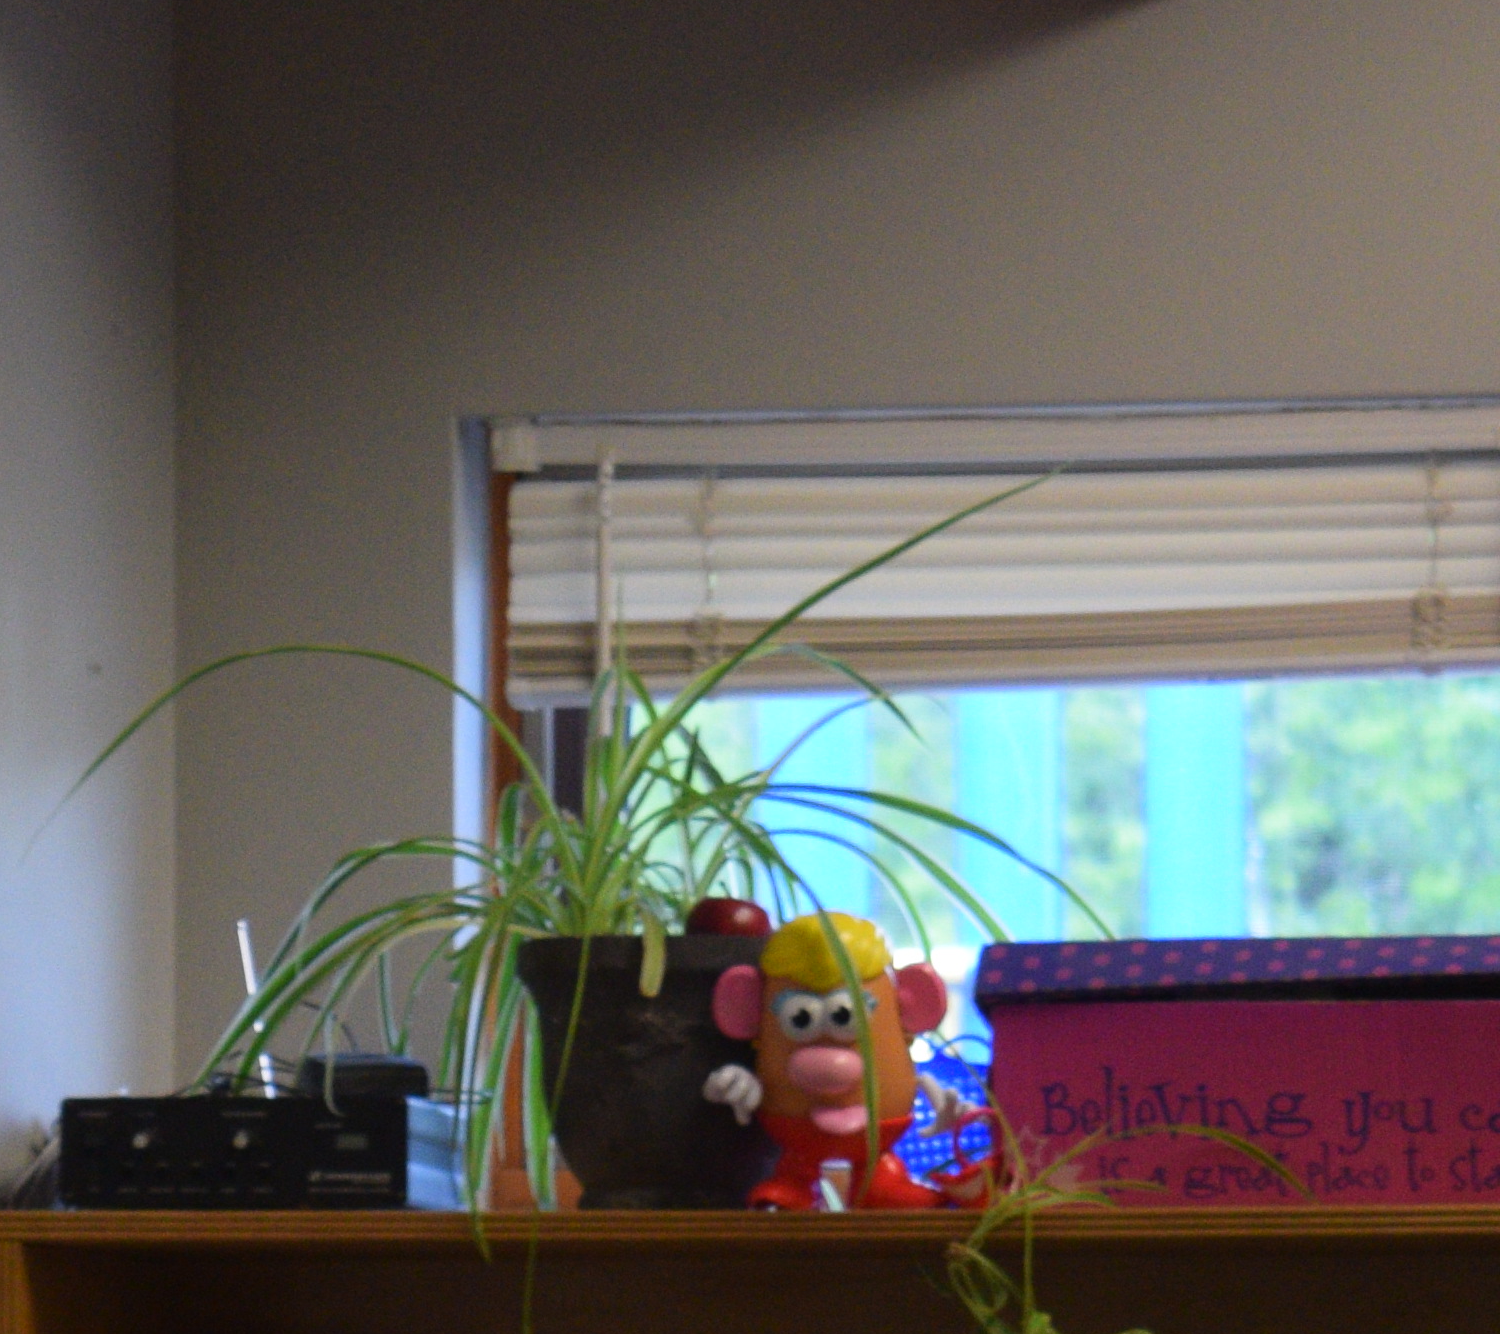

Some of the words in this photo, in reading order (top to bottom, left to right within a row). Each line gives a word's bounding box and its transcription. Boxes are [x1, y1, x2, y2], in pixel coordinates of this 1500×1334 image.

[1041, 1066, 1313, 1141] Believing
[1341, 1090, 1438, 1156] you
[1403, 1139, 1436, 1193] to
